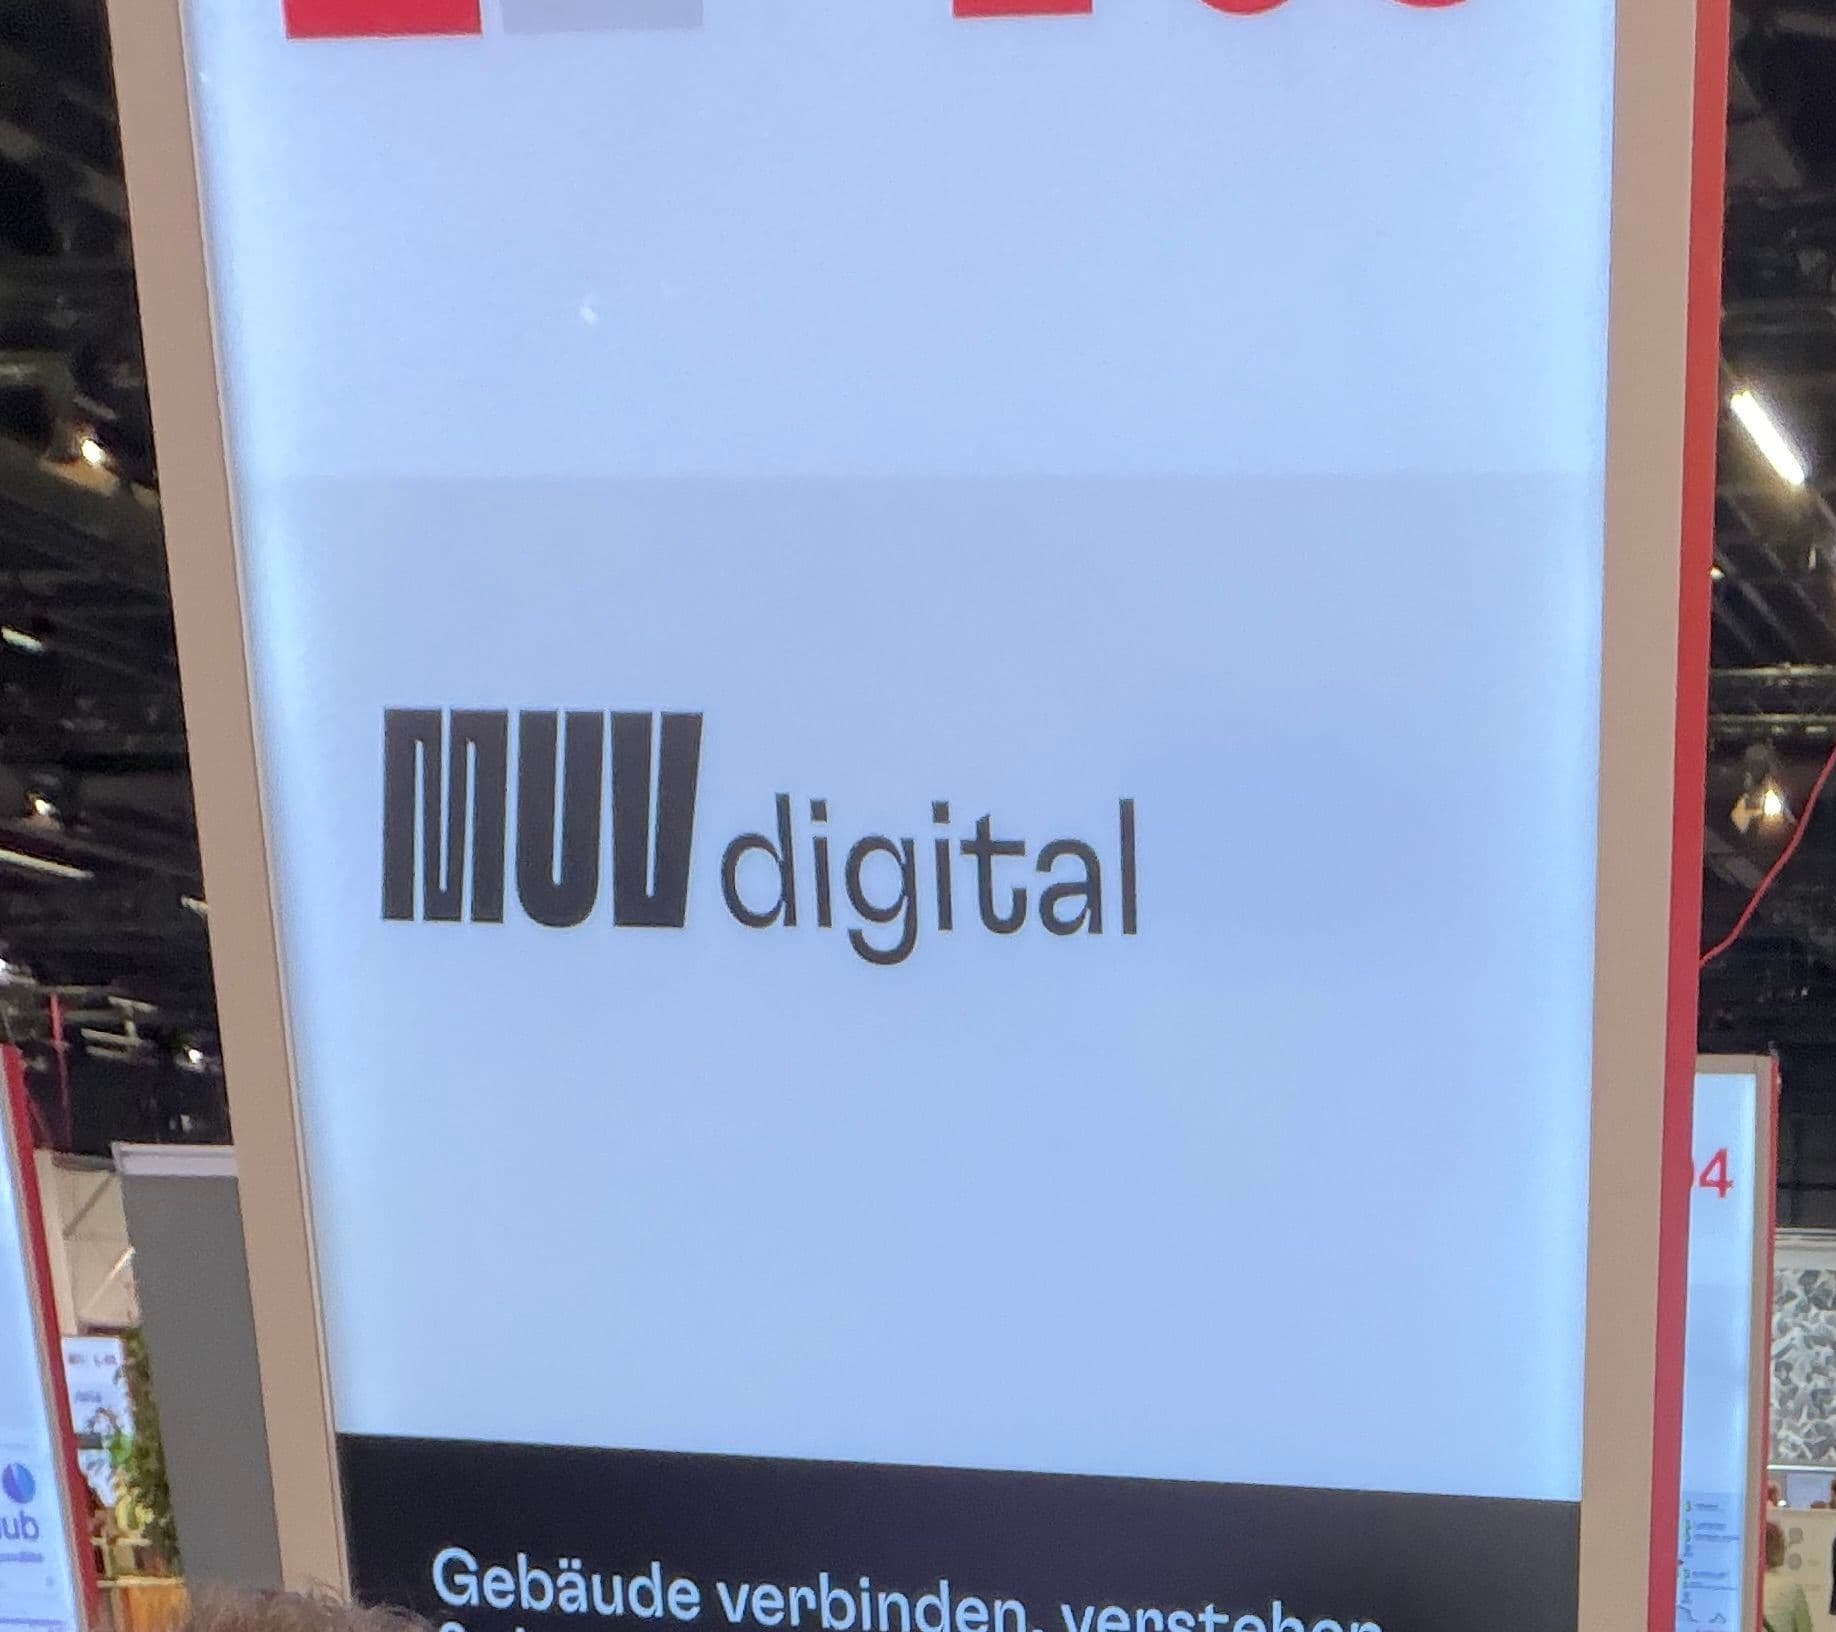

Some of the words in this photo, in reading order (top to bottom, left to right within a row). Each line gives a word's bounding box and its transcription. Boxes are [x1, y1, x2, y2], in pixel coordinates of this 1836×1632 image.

[380, 707, 704, 930] MUV
[719, 793, 1139, 967] digital
[432, 1546, 700, 1621] Gebäude
